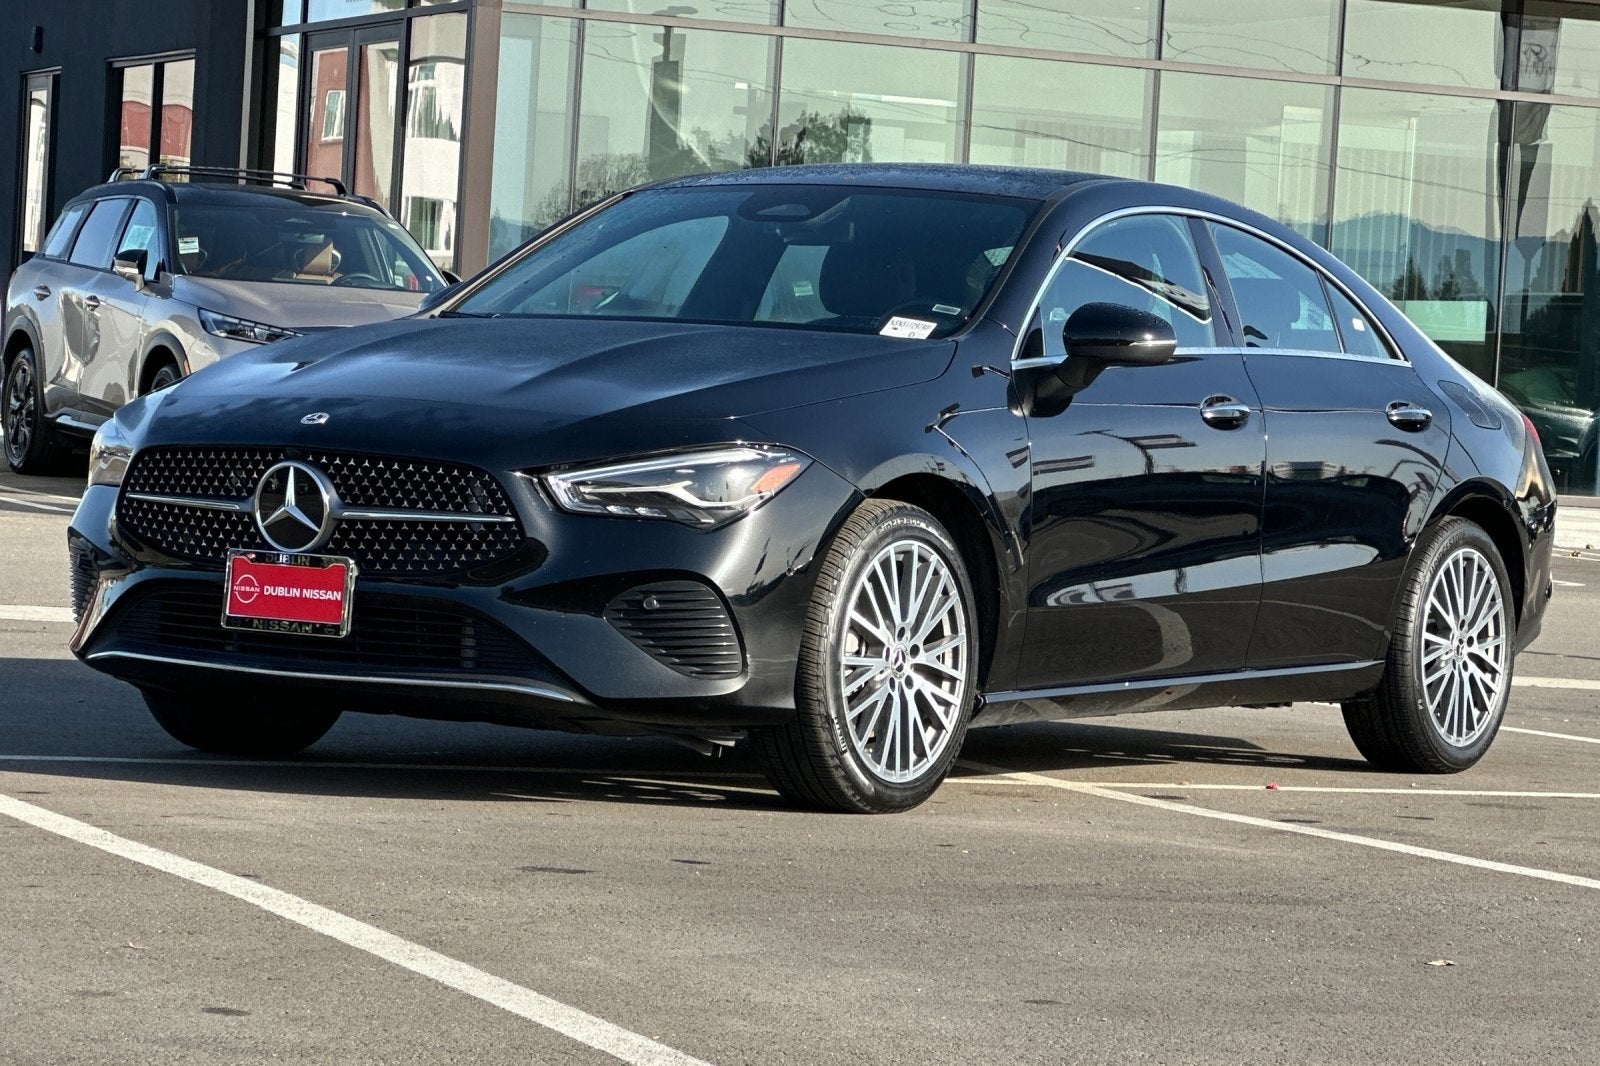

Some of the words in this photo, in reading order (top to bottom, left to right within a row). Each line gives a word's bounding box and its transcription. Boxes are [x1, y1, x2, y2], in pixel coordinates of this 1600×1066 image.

[266, 553, 310, 566] DUBLIN
[233, 584, 260, 593] NISSAN
[263, 585, 300, 598] DUBLIN
[302, 588, 342, 601] NISSAN
[252, 618, 313, 634] NISSAN
